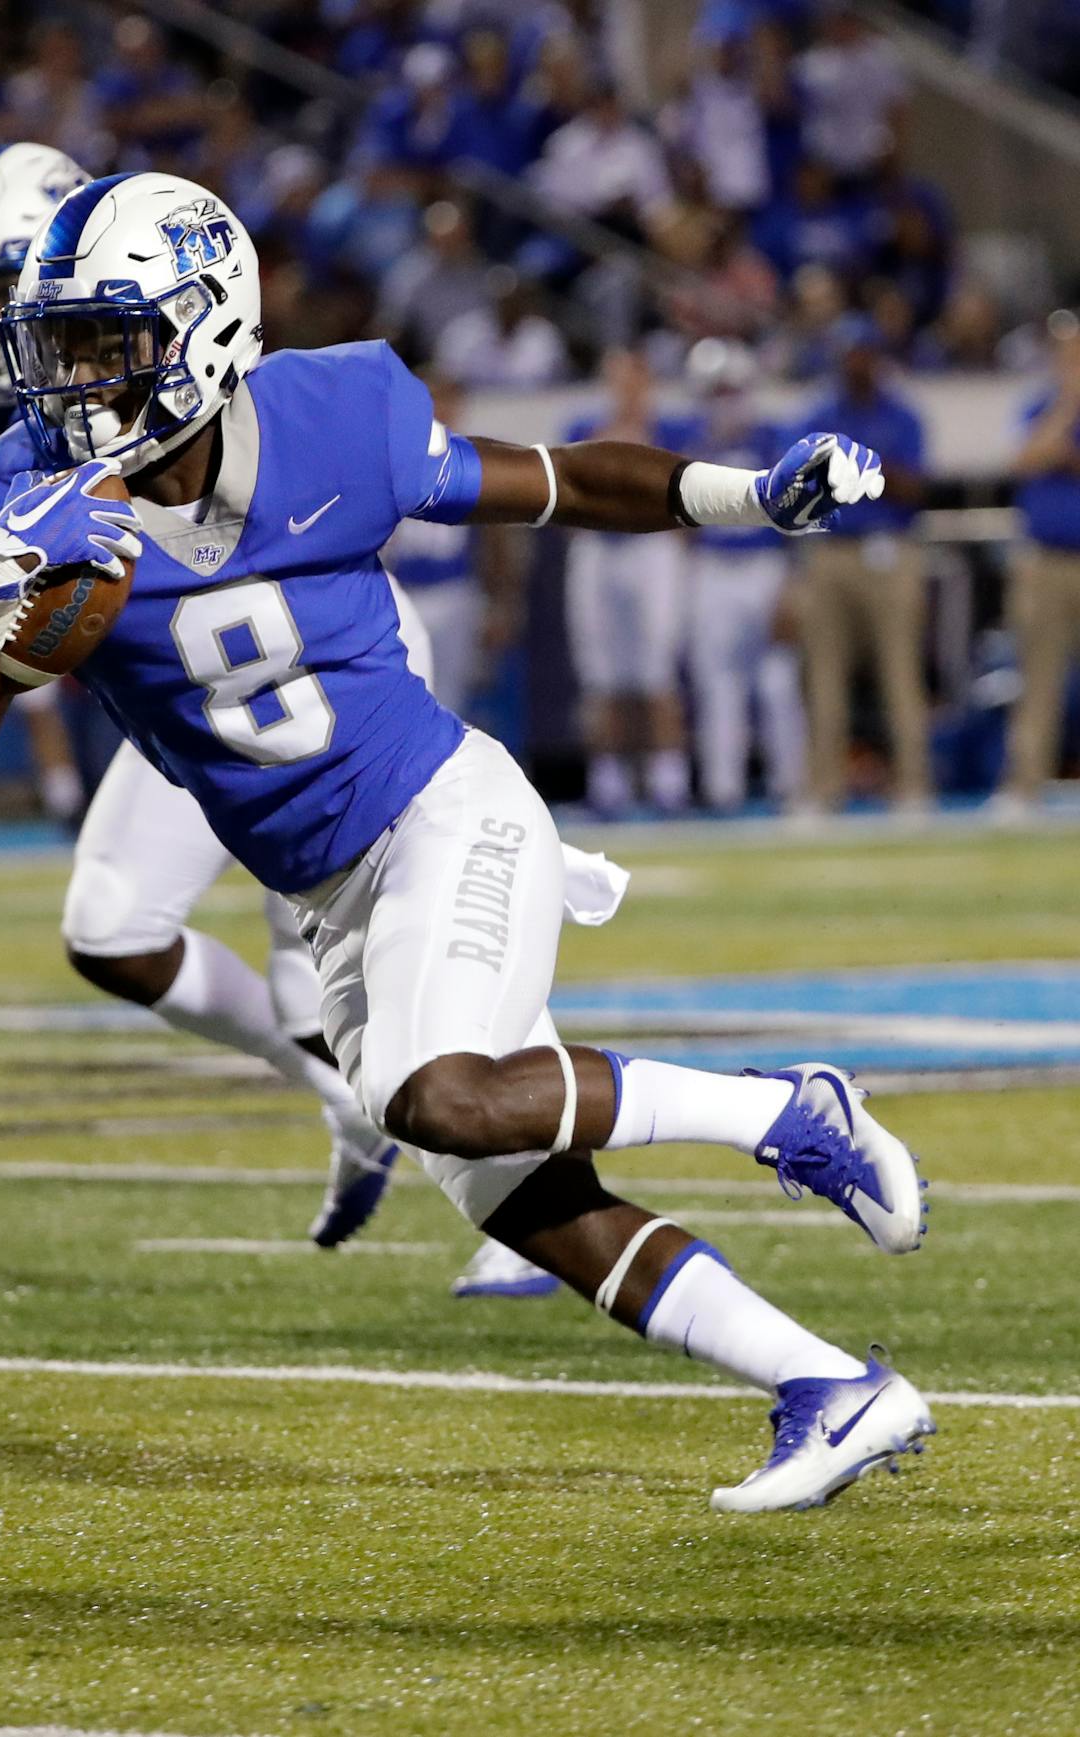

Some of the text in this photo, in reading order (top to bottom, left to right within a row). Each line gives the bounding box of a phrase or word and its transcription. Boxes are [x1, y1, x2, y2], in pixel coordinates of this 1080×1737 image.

[192, 543, 226, 567] MT
[169, 574, 336, 769] 8
[446, 817, 527, 974] RAIDERS
